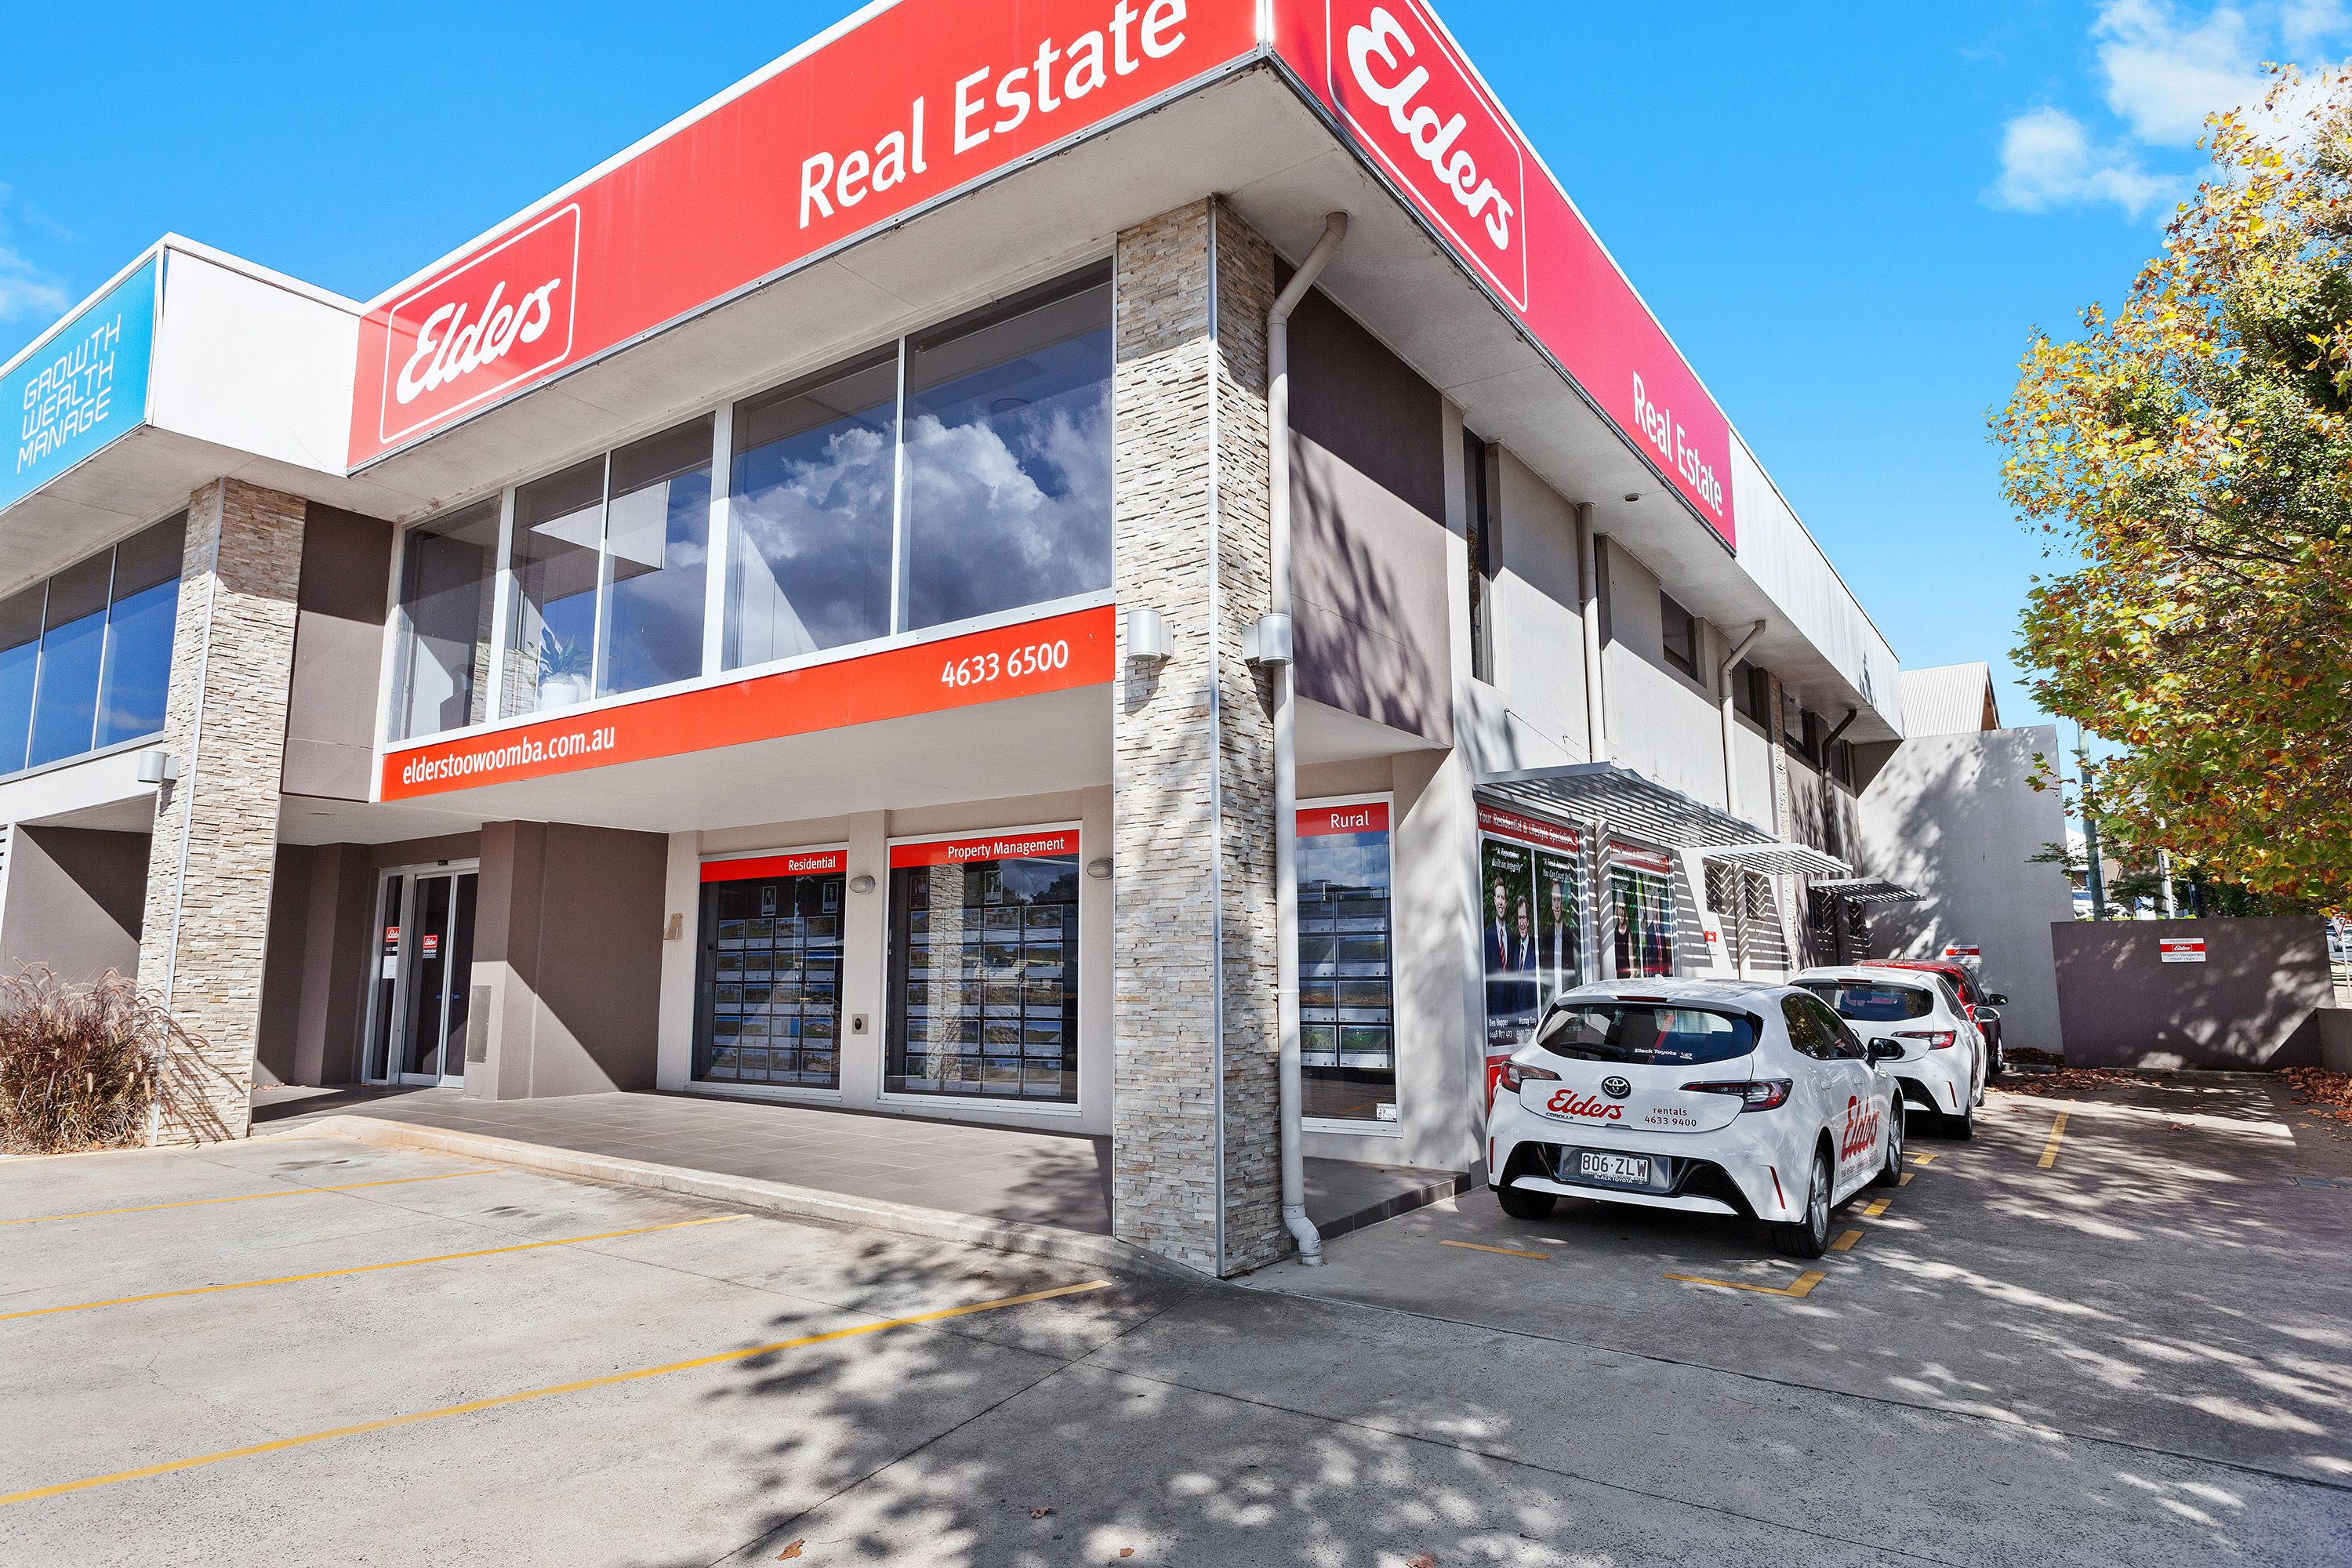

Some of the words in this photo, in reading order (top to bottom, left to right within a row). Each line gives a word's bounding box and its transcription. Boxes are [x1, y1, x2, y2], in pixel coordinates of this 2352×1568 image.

[800, 96, 927, 229] Real
[954, 0, 1187, 155] Estate
[1347, 6, 1513, 250] Elders
[24, 313, 122, 410] GROWTH
[396, 278, 561, 405] Elders
[22, 351, 114, 441] WEALTH
[17, 387, 111, 474] MANAGE
[1633, 370, 1673, 463] Real
[1676, 423, 1723, 517] Estate
[942, 652, 1000, 688] 4633
[1007, 640, 1069, 677] 6500
[403, 726, 615, 784] elderstoowoomba.com.au
[1330, 810, 1369, 829] Rural
[1479, 809, 1492, 824] Your
[1493, 814, 1522, 832] Residential
[1523, 822, 1528, 833] &
[1529, 823, 1548, 840] Lifestyle
[789, 855, 836, 871] Residential
[948, 844, 991, 860] Property
[993, 837, 1065, 855] Management
[1496, 1018, 1508, 1028] Hopper
[1545, 1112, 1573, 1120] COROLLA
[1547, 1089, 1624, 1120] Elders
[1644, 1116, 1668, 1125] 4633
[1671, 1118, 1697, 1127] 9400
[1841, 1095, 1879, 1162] Elders
